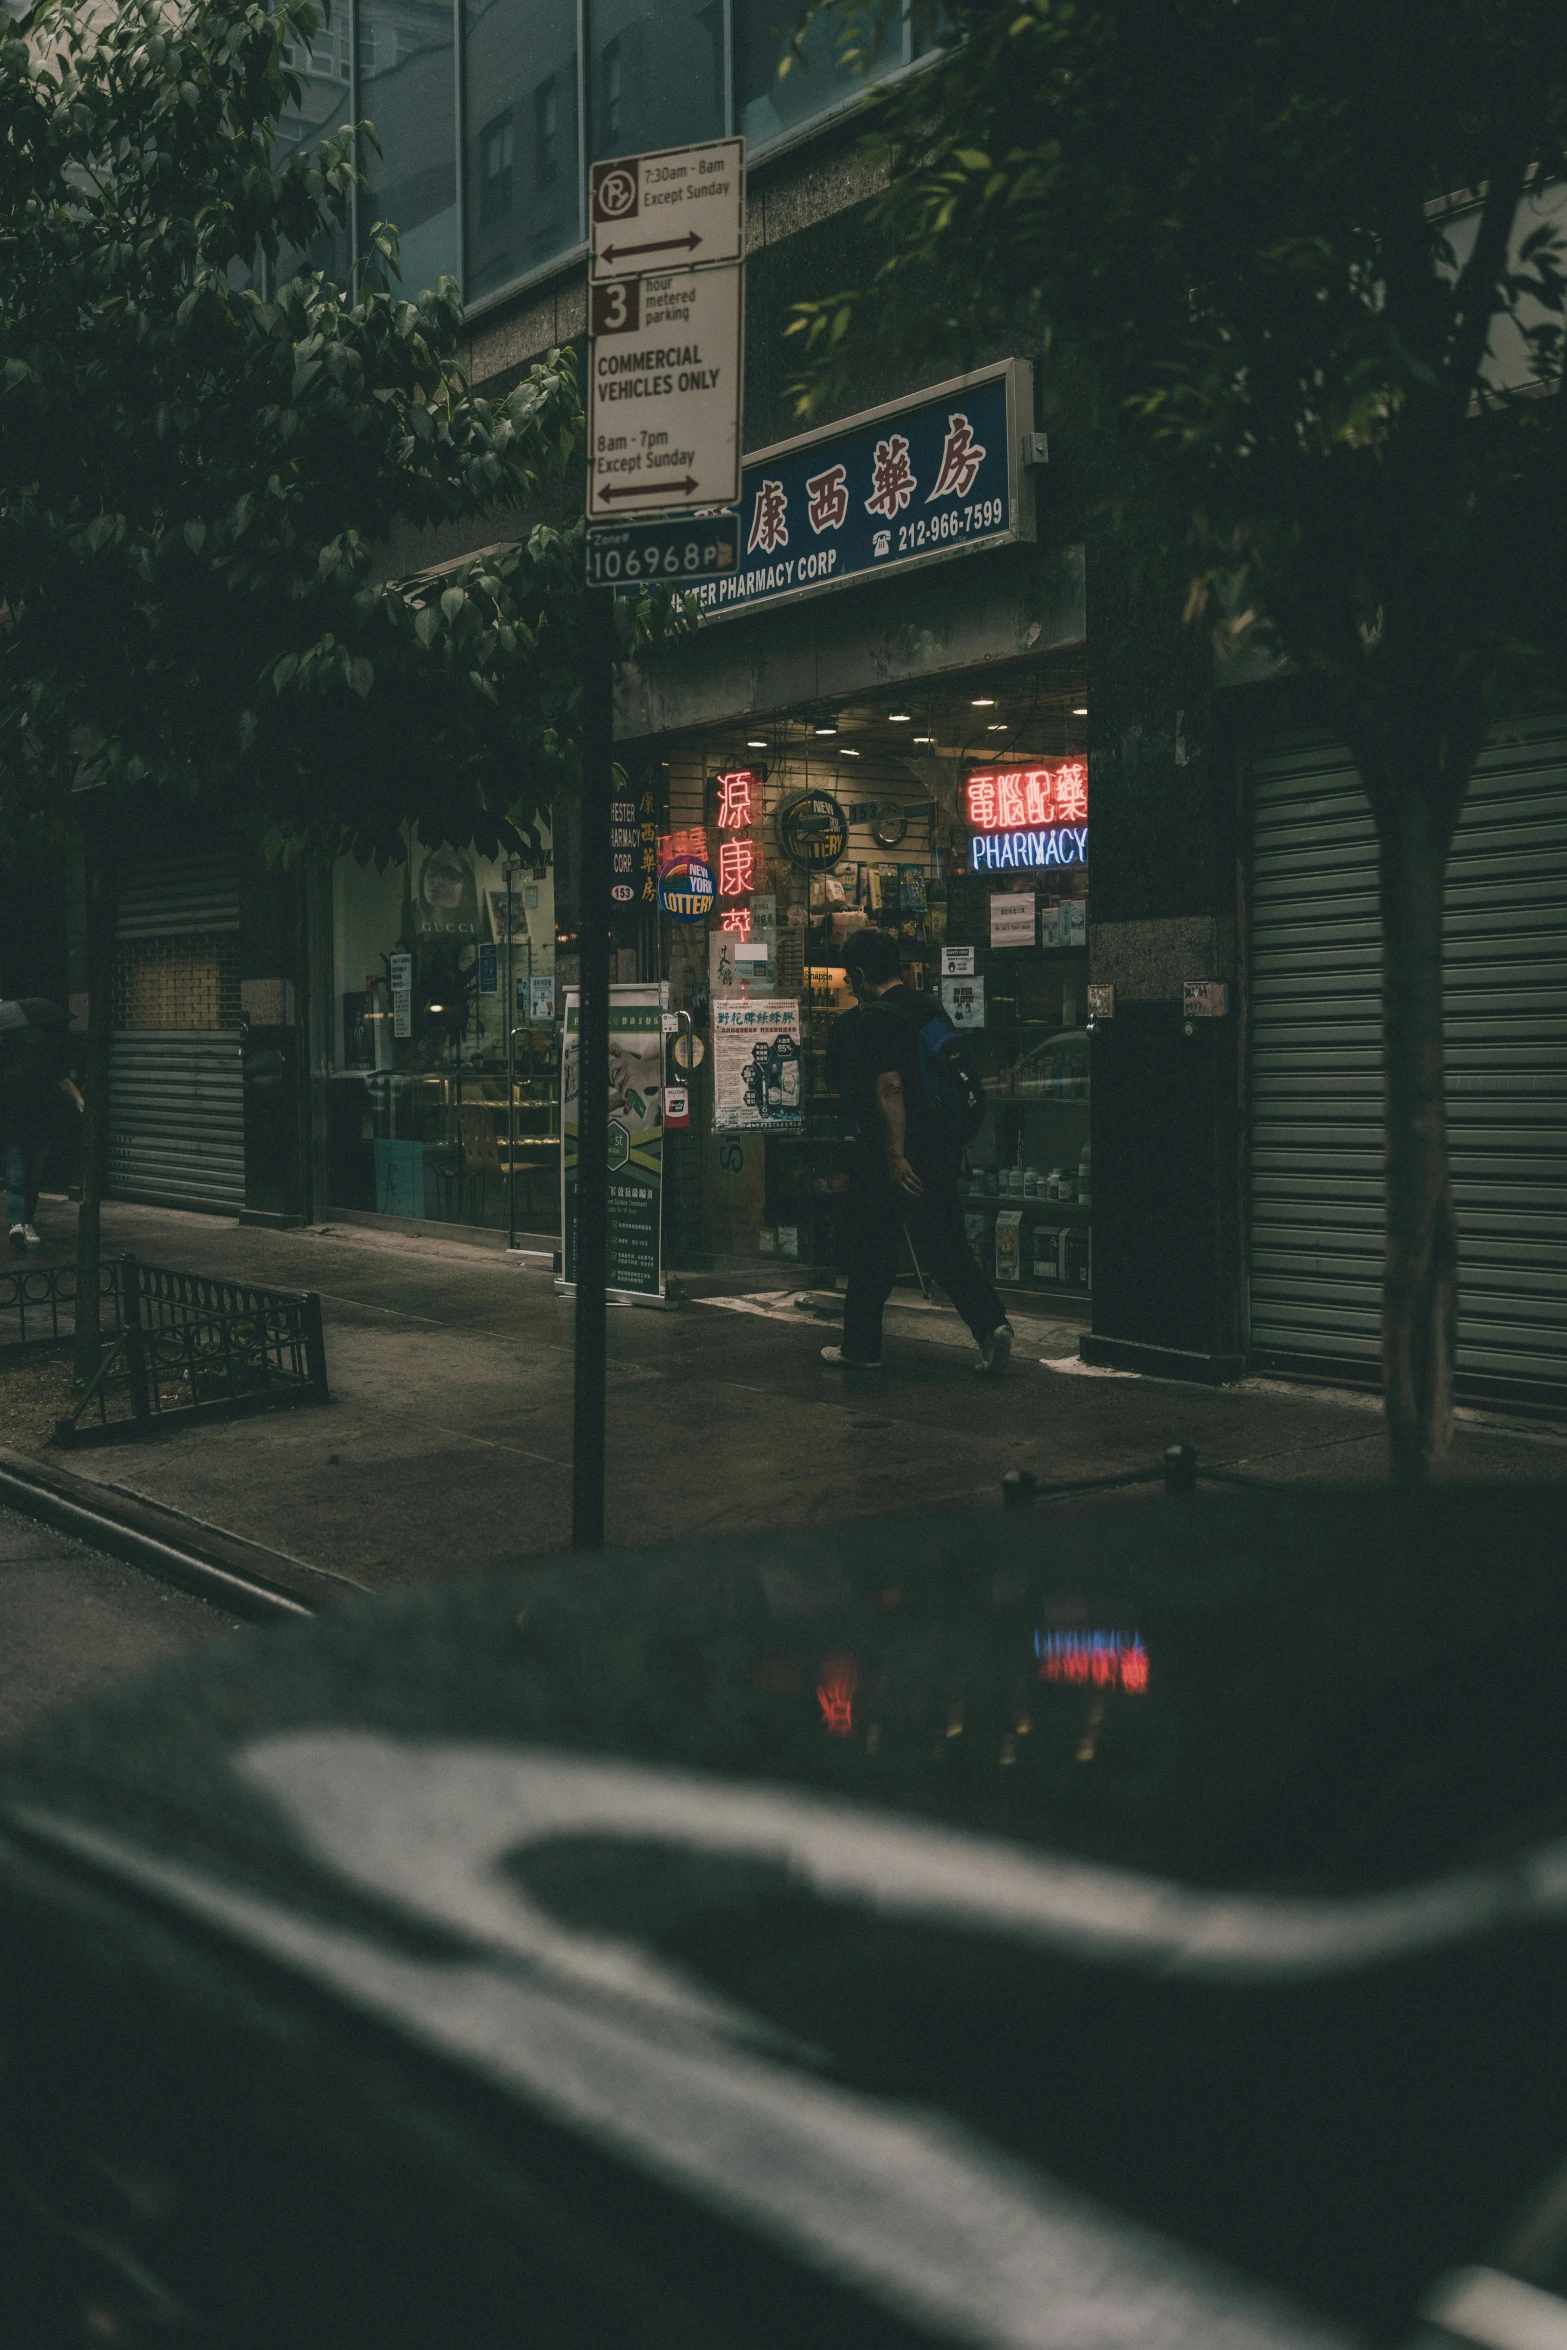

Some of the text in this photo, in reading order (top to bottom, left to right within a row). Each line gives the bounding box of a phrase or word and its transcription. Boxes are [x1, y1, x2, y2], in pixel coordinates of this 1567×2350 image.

[645, 167, 687, 184] 7:30am
[700, 160, 725, 175] 8am
[644, 181, 730, 207] Except Sunday
[646, 277, 674, 292] hour
[604, 283, 628, 329] 3
[646, 288, 696, 308] metered
[646, 306, 690, 328] parking
[598, 344, 703, 377] COMMERCIAL
[598, 368, 720, 403] VEHICLES ONLY
[597, 434, 627, 452] 8am
[640, 430, 668, 450] 7pm
[597, 449, 696, 475] Except Sunday
[693, 412, 986, 556] 康西藥房
[899, 496, 1003, 553] 212-966-7599
[719, 562, 795, 605] PHARMACY
[797, 549, 837, 580] CORP
[611, 802, 635, 823] HESTER
[813, 799, 835, 816] NEW
[852, 802, 878, 822] 153
[611, 827, 641, 848] HARMACY
[788, 834, 843, 858] LOTERY
[972, 827, 1089, 871] PHARMACY
[613, 853, 633, 874] CORP.
[689, 863, 709, 879] NEW
[614, 887, 631, 899] 153
[690, 877, 713, 894] YORK
[663, 891, 714, 915] LOTTERY
[421, 921, 474, 933] GUCCI
[804, 970, 833, 982] Snappe
